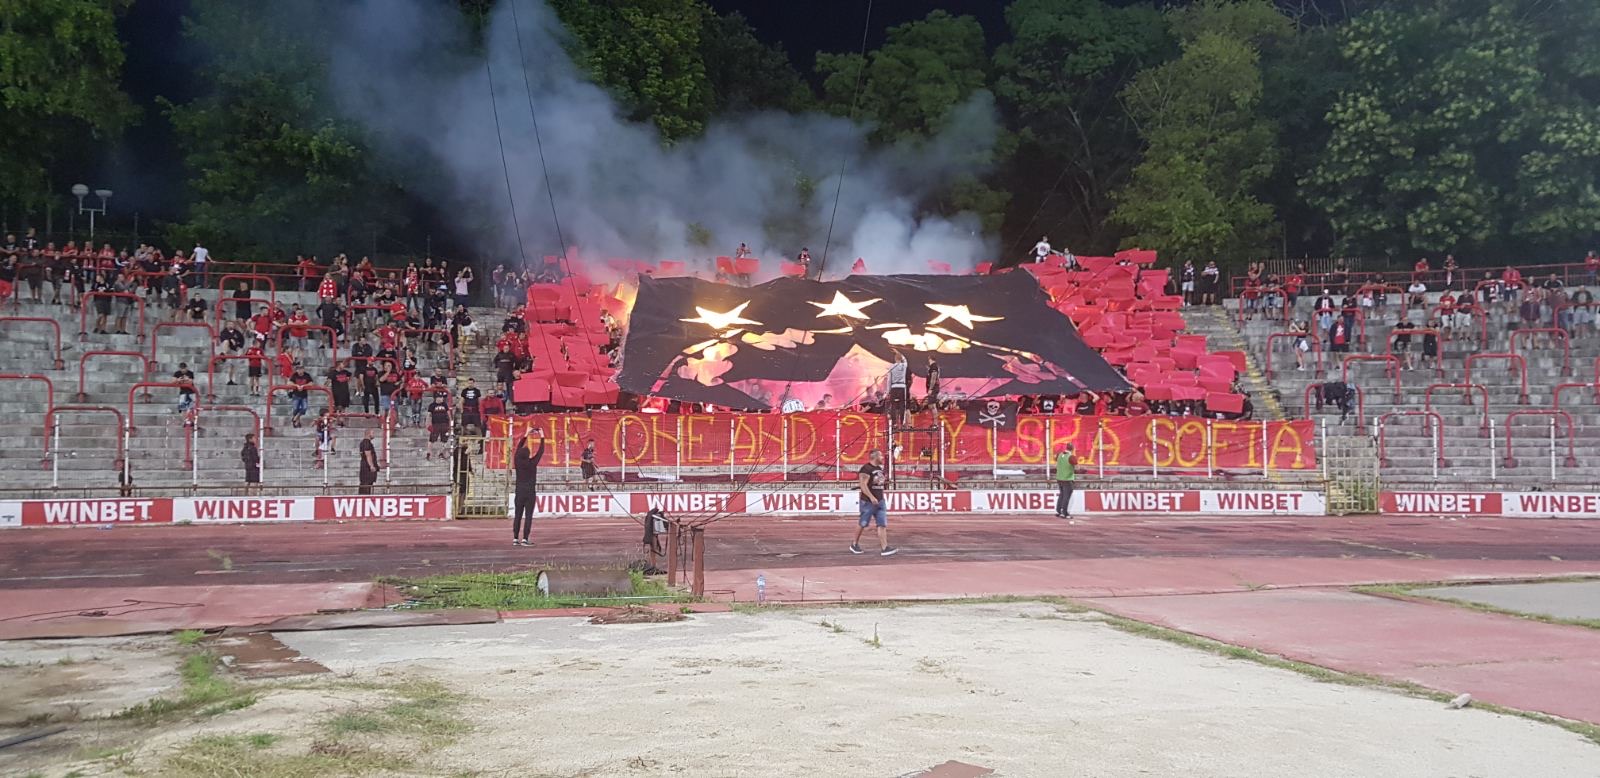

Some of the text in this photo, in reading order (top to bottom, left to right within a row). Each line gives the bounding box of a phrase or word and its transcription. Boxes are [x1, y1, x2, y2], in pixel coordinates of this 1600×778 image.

[489, 415, 592, 464] THE
[613, 414, 715, 464] ONE
[723, 415, 816, 464] AND
[1144, 418, 1305, 468] SOFIA
[194, 499, 295, 519] WINBET
[333, 497, 429, 517] WINBET
[647, 493, 730, 512] WINBET
[762, 493, 844, 511] WINBET
[987, 493, 1060, 510] WINBE
[1100, 492, 1185, 511] WINBET
[1217, 493, 1303, 511] WINBET
[1395, 494, 1486, 513] WINBET
[1520, 495, 1600, 513] WINBE
[43, 501, 153, 523] WINBET
